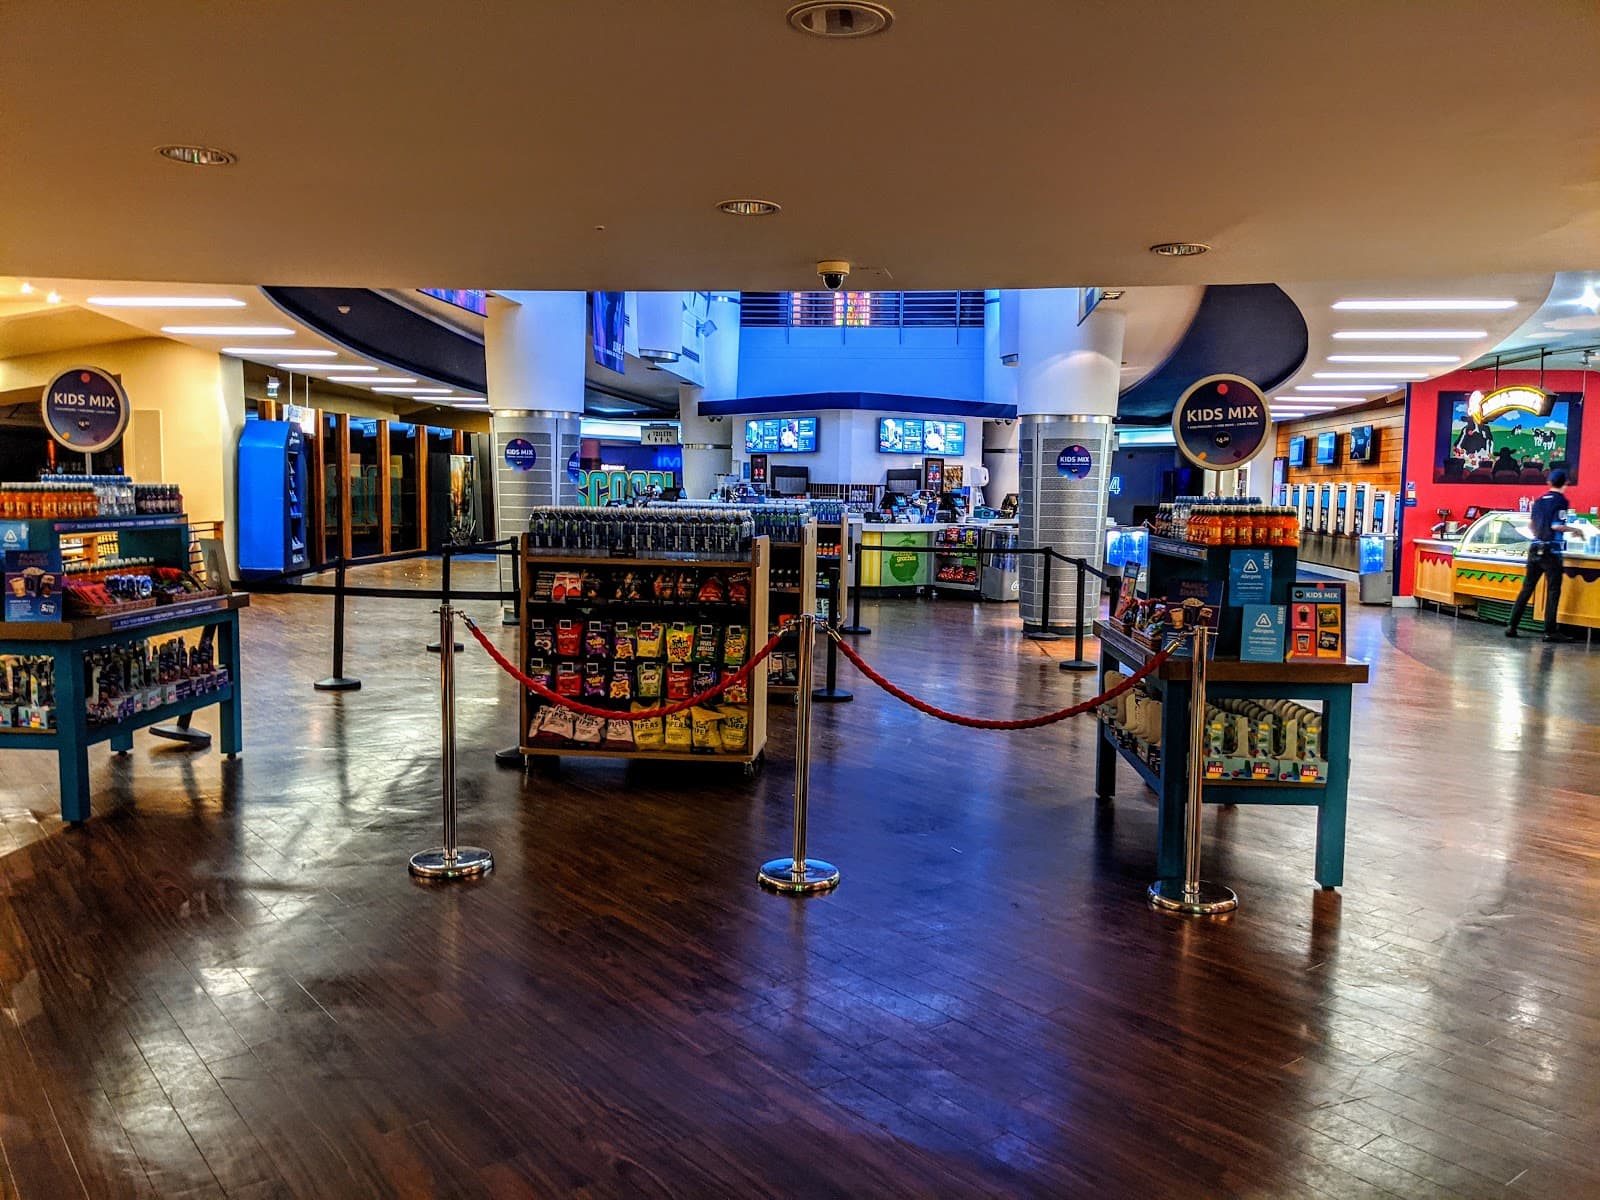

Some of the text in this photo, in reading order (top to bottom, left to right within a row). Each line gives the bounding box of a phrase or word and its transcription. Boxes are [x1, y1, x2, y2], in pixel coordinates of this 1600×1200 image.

[54, 391, 115, 408] KIDS MIX
[1186, 405, 1259, 423] KIDS MIX
[506, 448, 520, 456] KIDS
[1060, 455, 1089, 463] KIDS MIX
[1108, 476, 1121, 495] 4
[1305, 591, 1322, 599] KIDS
[1324, 591, 1338, 599] MIX
